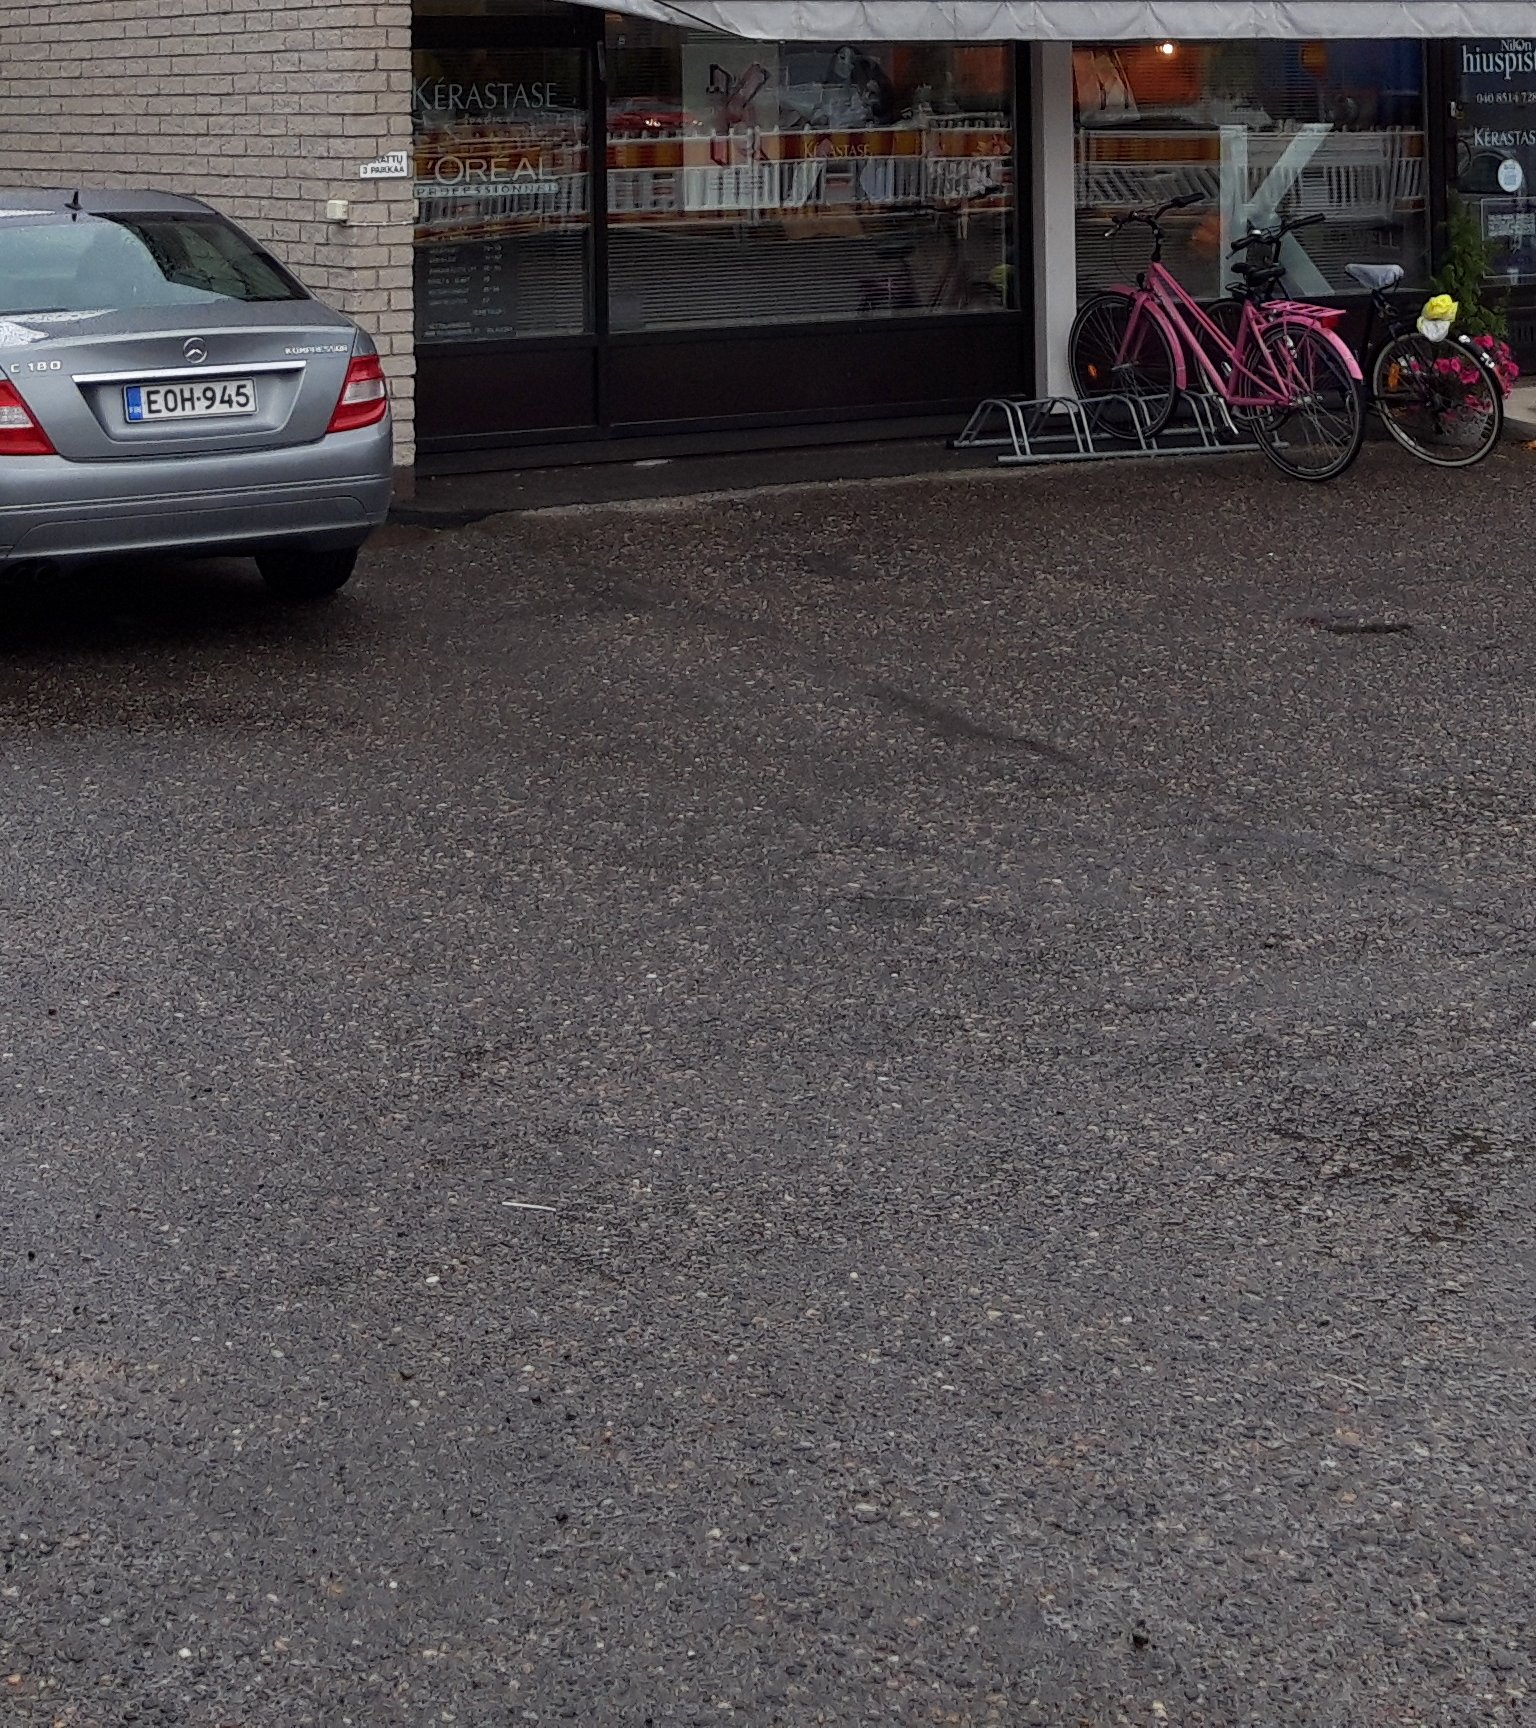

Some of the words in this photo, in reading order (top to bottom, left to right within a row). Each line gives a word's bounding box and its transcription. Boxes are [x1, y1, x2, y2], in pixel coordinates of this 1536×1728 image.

[413, 75, 560, 111] KÉRASTASE
[10, 363, 20, 373] C
[28, 360, 62, 372] 180
[146, 383, 251, 415] EOH-945
